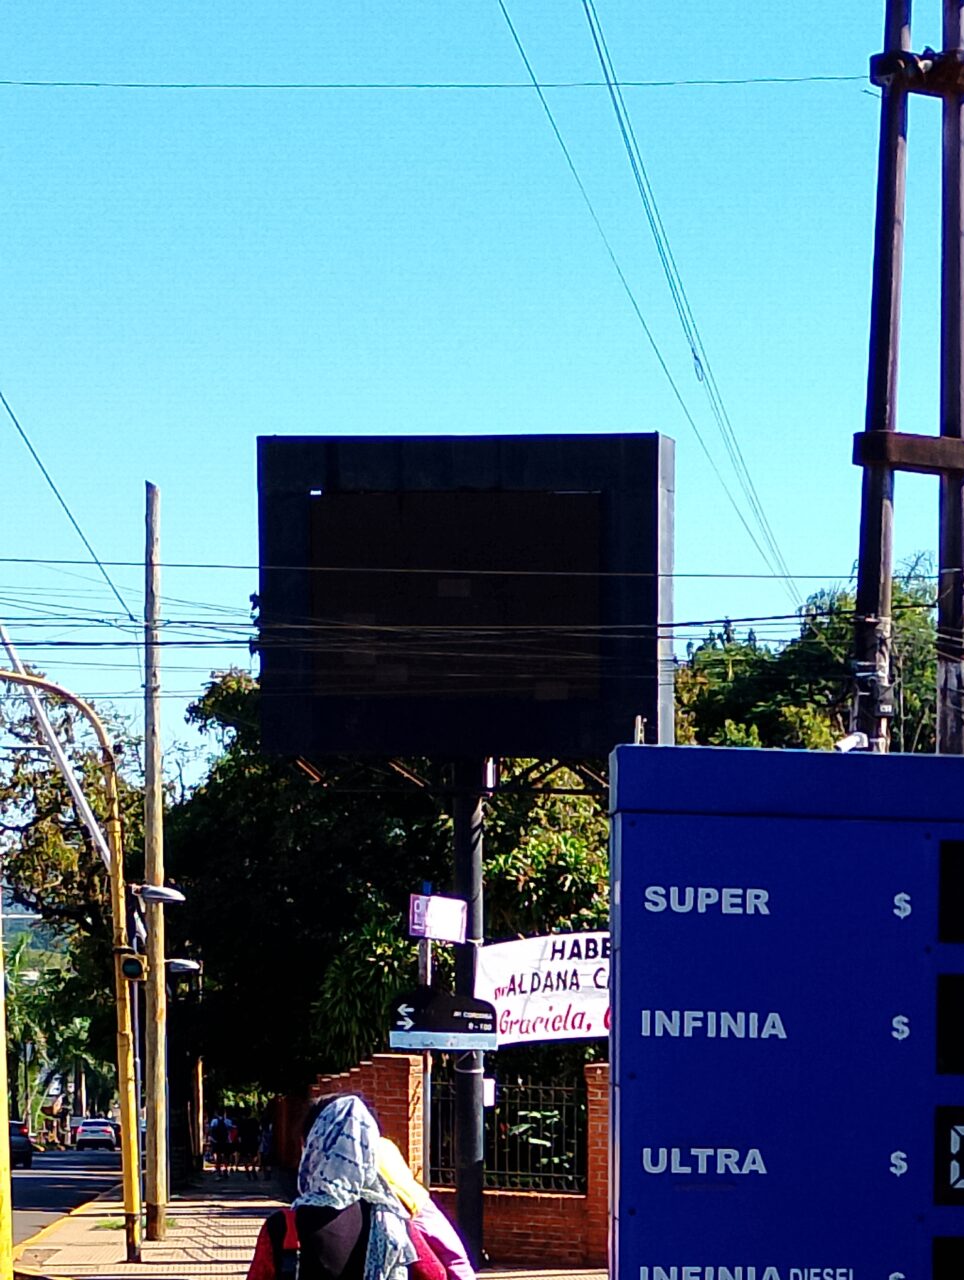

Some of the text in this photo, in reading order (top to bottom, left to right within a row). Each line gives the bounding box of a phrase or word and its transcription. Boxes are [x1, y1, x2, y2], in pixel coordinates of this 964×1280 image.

[644, 886, 770, 914] SUPER
[893, 892, 911, 918] $
[593, 967, 610, 990] C
[641, 1010, 787, 1039] INFINIA
[891, 1014, 909, 1041] $
[642, 1147, 767, 1175] ULTRA
[889, 1149, 908, 1176] $
